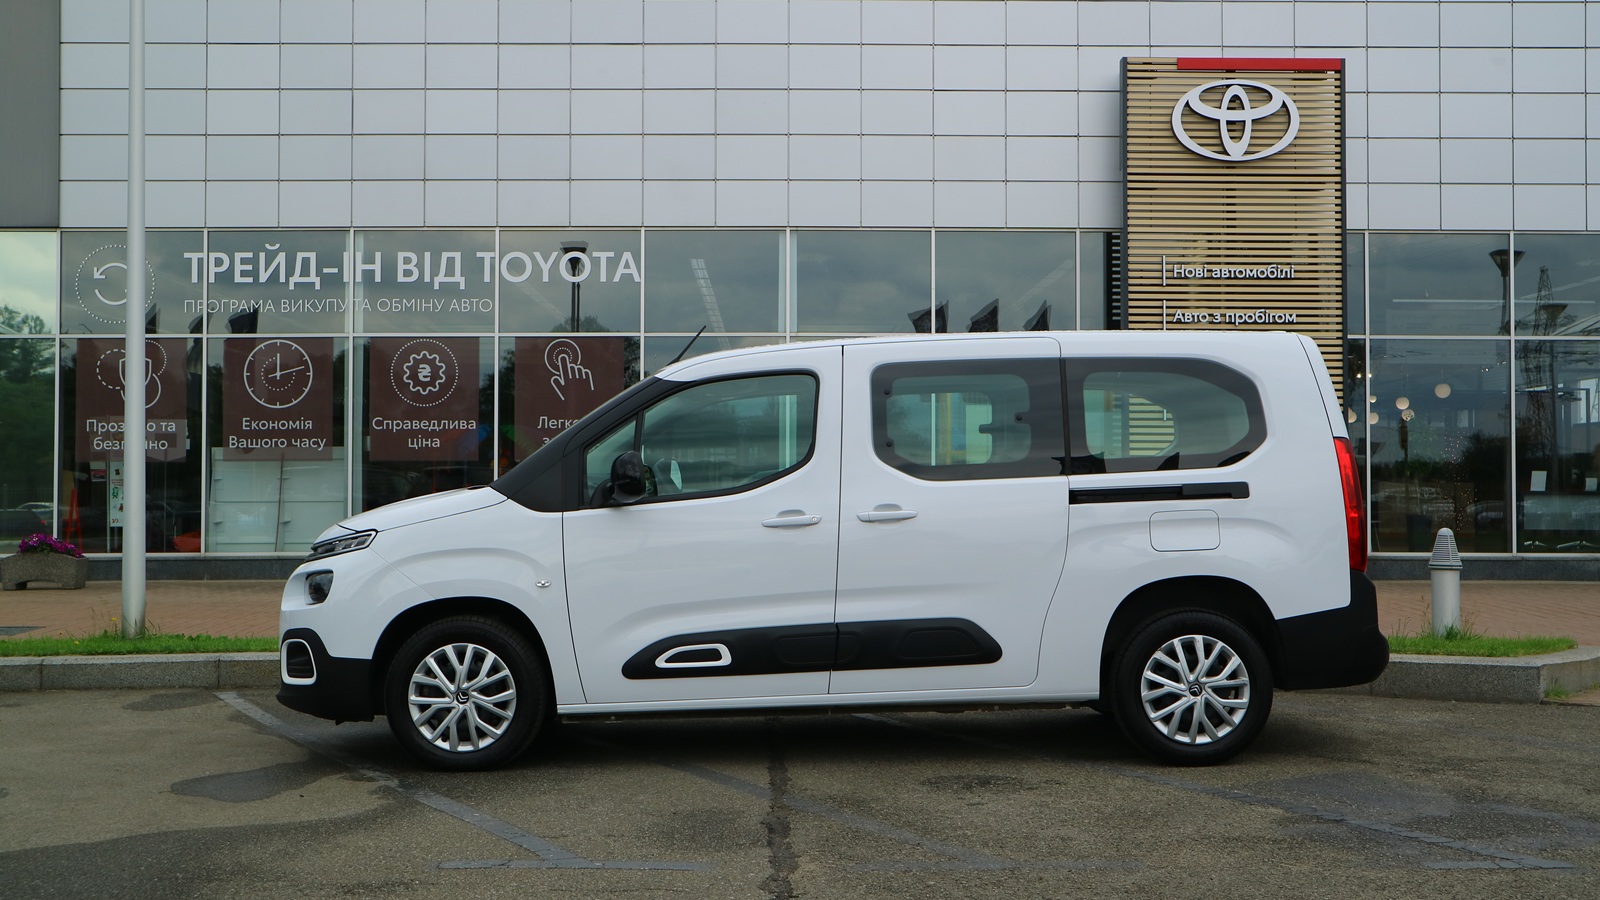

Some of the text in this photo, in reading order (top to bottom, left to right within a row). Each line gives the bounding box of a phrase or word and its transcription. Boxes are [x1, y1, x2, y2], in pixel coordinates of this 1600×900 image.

[183, 243, 641, 290] ТРЕЙД-ІН ВІД TOYOTA
[1173, 264, 1295, 278] Нові автомобілі
[184, 298, 493, 314] ПРОГРАМА ВИКУПУ ТА ОБМІНУ АВТО
[1173, 309, 1297, 326] Авто з пробігом
[86, 419, 176, 435] Прозо та
[242, 416, 313, 431] Економія
[372, 417, 477, 432] Справедлива
[93, 436, 168, 450] безно
[229, 436, 326, 452] Вашого часу
[408, 435, 441, 449] ціна
